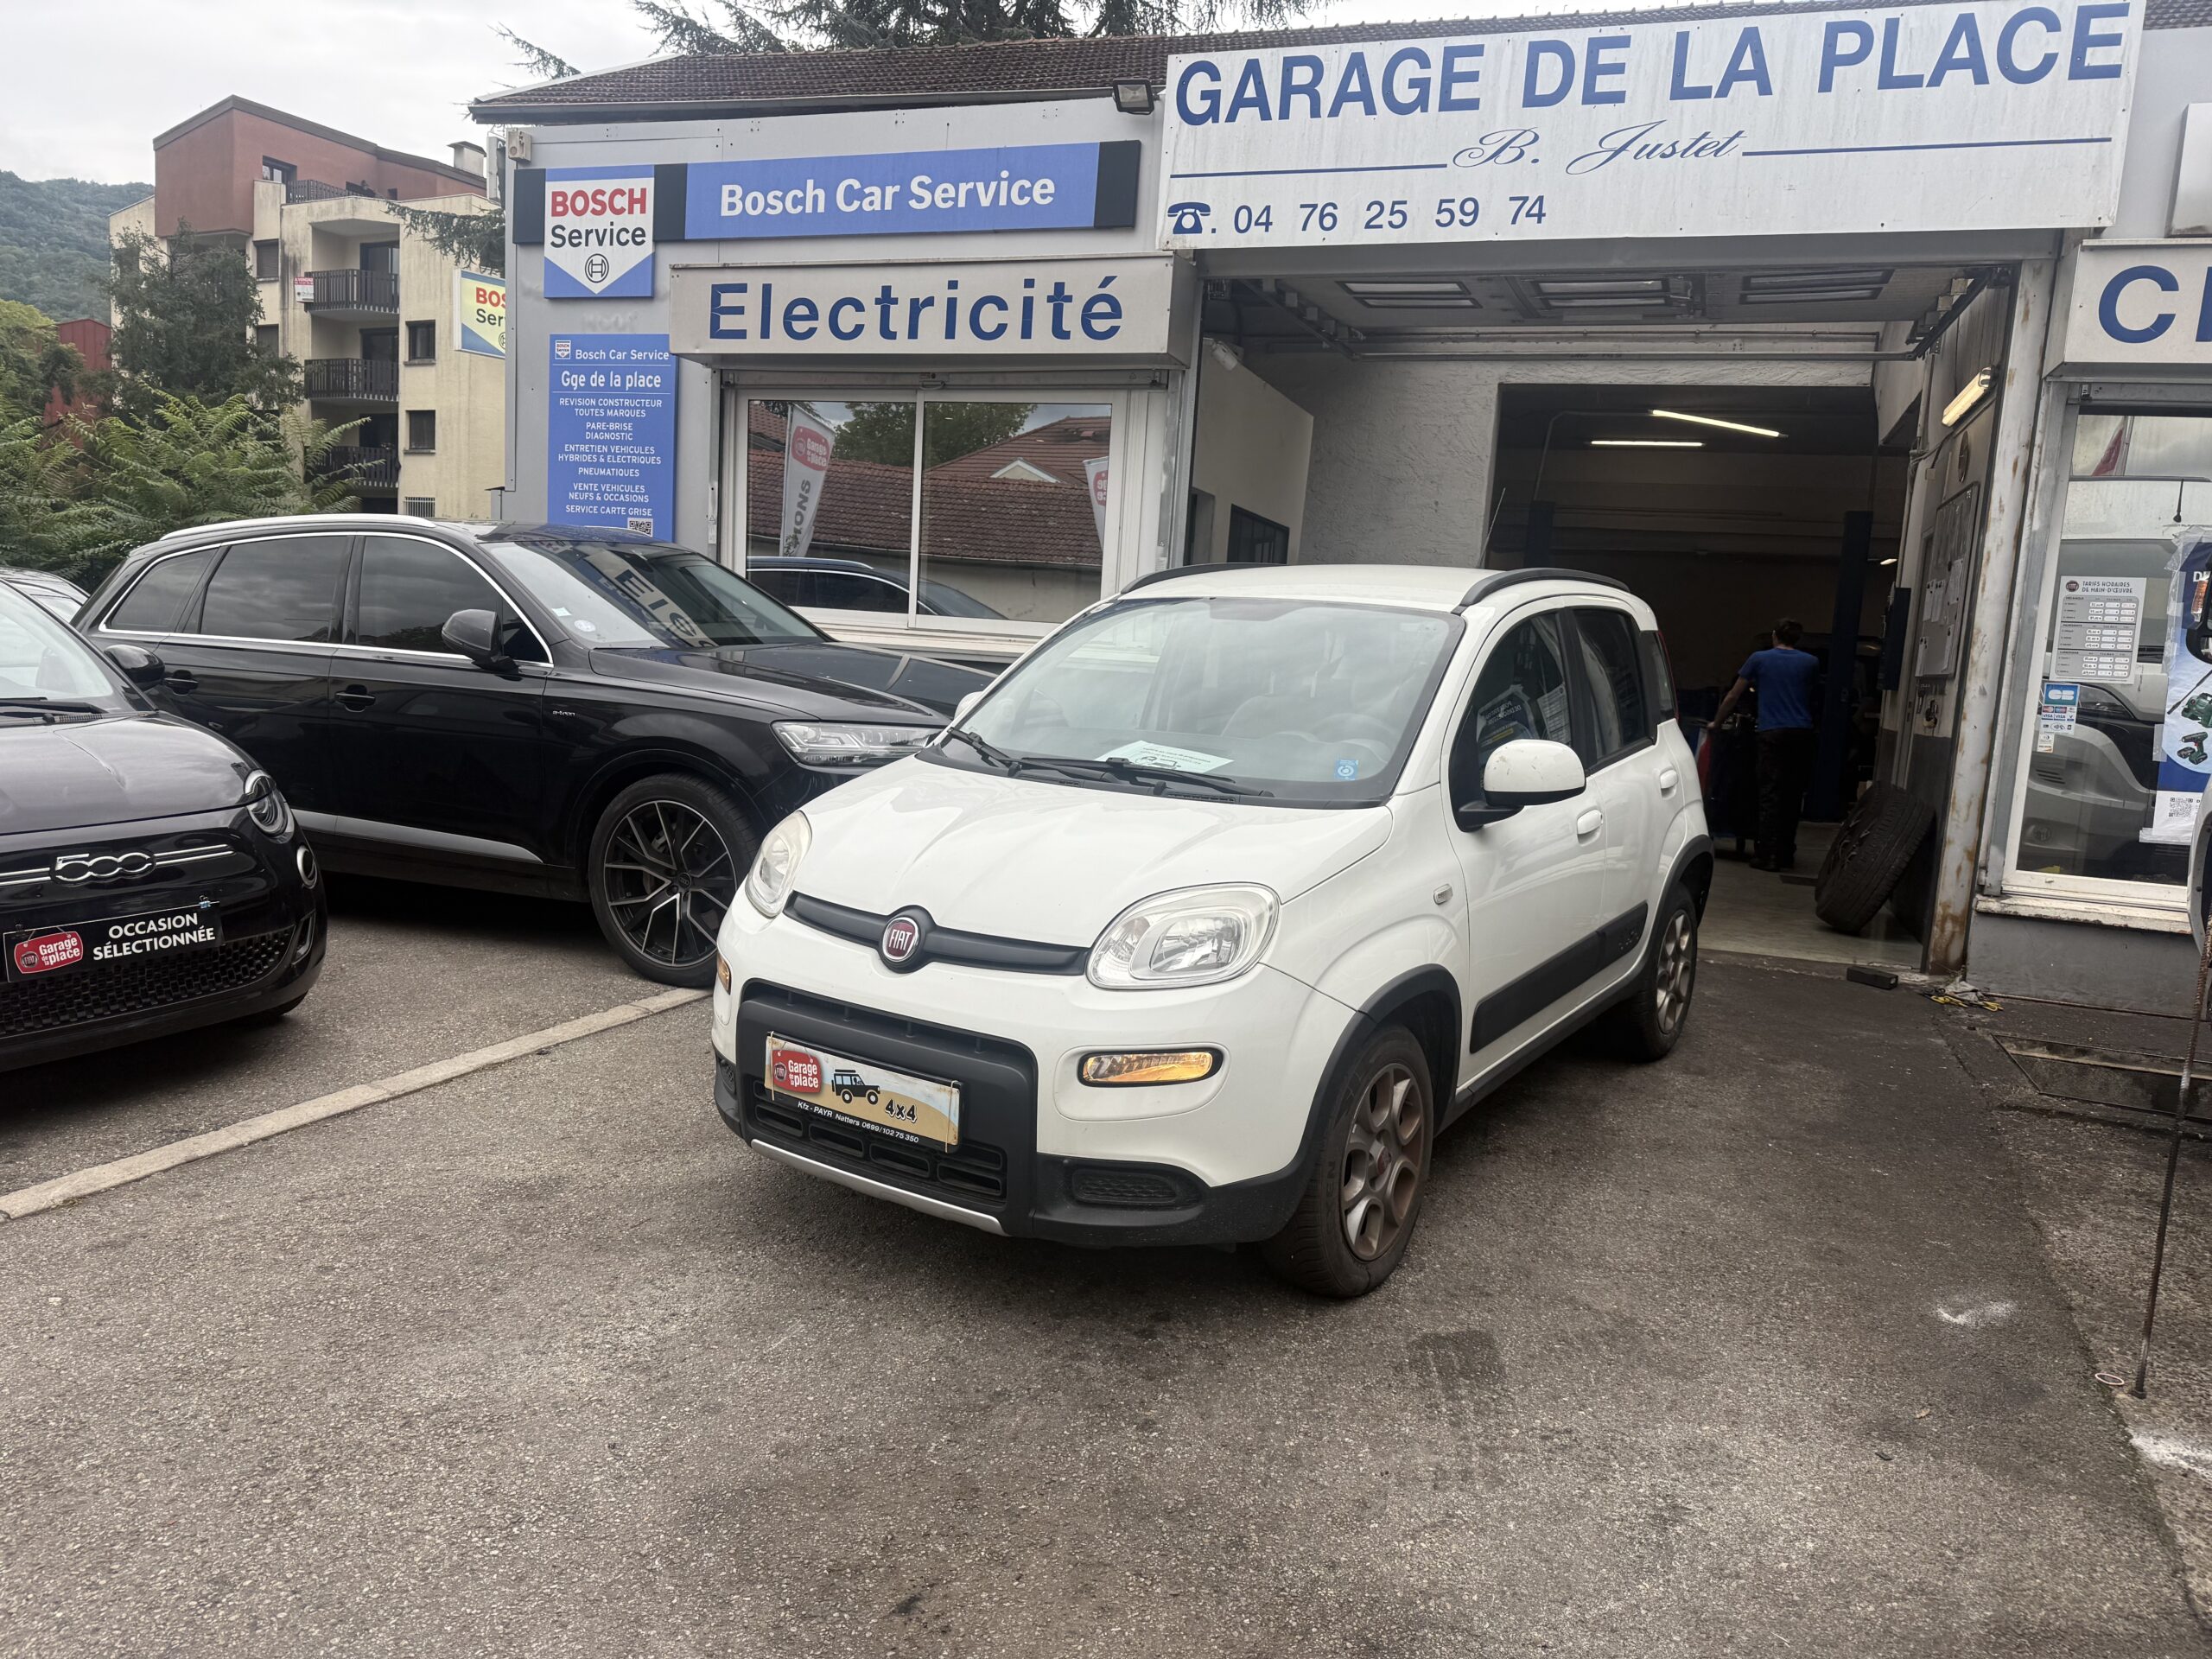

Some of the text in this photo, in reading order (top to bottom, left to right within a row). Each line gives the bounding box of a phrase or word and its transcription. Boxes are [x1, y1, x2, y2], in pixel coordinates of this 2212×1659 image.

[1175, 2, 2131, 126] GARAGE DE LA PLACE
[1452, 119, 1748, 175] B. Justet
[550, 188, 647, 218] BOSCH
[721, 171, 1056, 217] Bosch Car Service
[1234, 195, 1547, 234] 04 76 25 59 74
[550, 222, 646, 248] Service
[709, 275, 1123, 340] Electricité
[476, 308, 505, 327] Ser
[575, 349, 670, 360] Bosch Car Service
[562, 371, 661, 391] Gge de la place
[559, 397, 663, 408] REVISION CONSTRUCTEUR
[575, 408, 646, 417] TOUTES MARQUES
[586, 432, 633, 441] DIAGNOSTIC
[564, 444, 655, 454] ENTRETIEN VEHICULES
[558, 454, 597, 462] HYBRIDES
[607, 455, 662, 465] ELECTRIQUES
[578, 467, 640, 477] PNEUMATIQUES
[573, 483, 645, 493] VENTE VEHICULES
[569, 493, 594, 501] NEUFS
[604, 493, 649, 503] OCCASIONS
[566, 505, 652, 517] SERVICE CARTE GRISE
[55, 853, 155, 882] 500
[109, 912, 198, 939] OCCASION
[39, 938, 78, 956] Garage
[92, 927, 216, 962] SÉLECTIONNÉE
[888, 929, 912, 950] FIAT
[49, 947, 80, 966] place
[788, 1059, 818, 1077] Garage
[794, 1073, 819, 1089] place
[798, 1101, 810, 1111] Kfz
[813, 1106, 833, 1118] PAYR
[835, 1113, 861, 1127] Natters
[884, 1098, 918, 1123] 4x4
